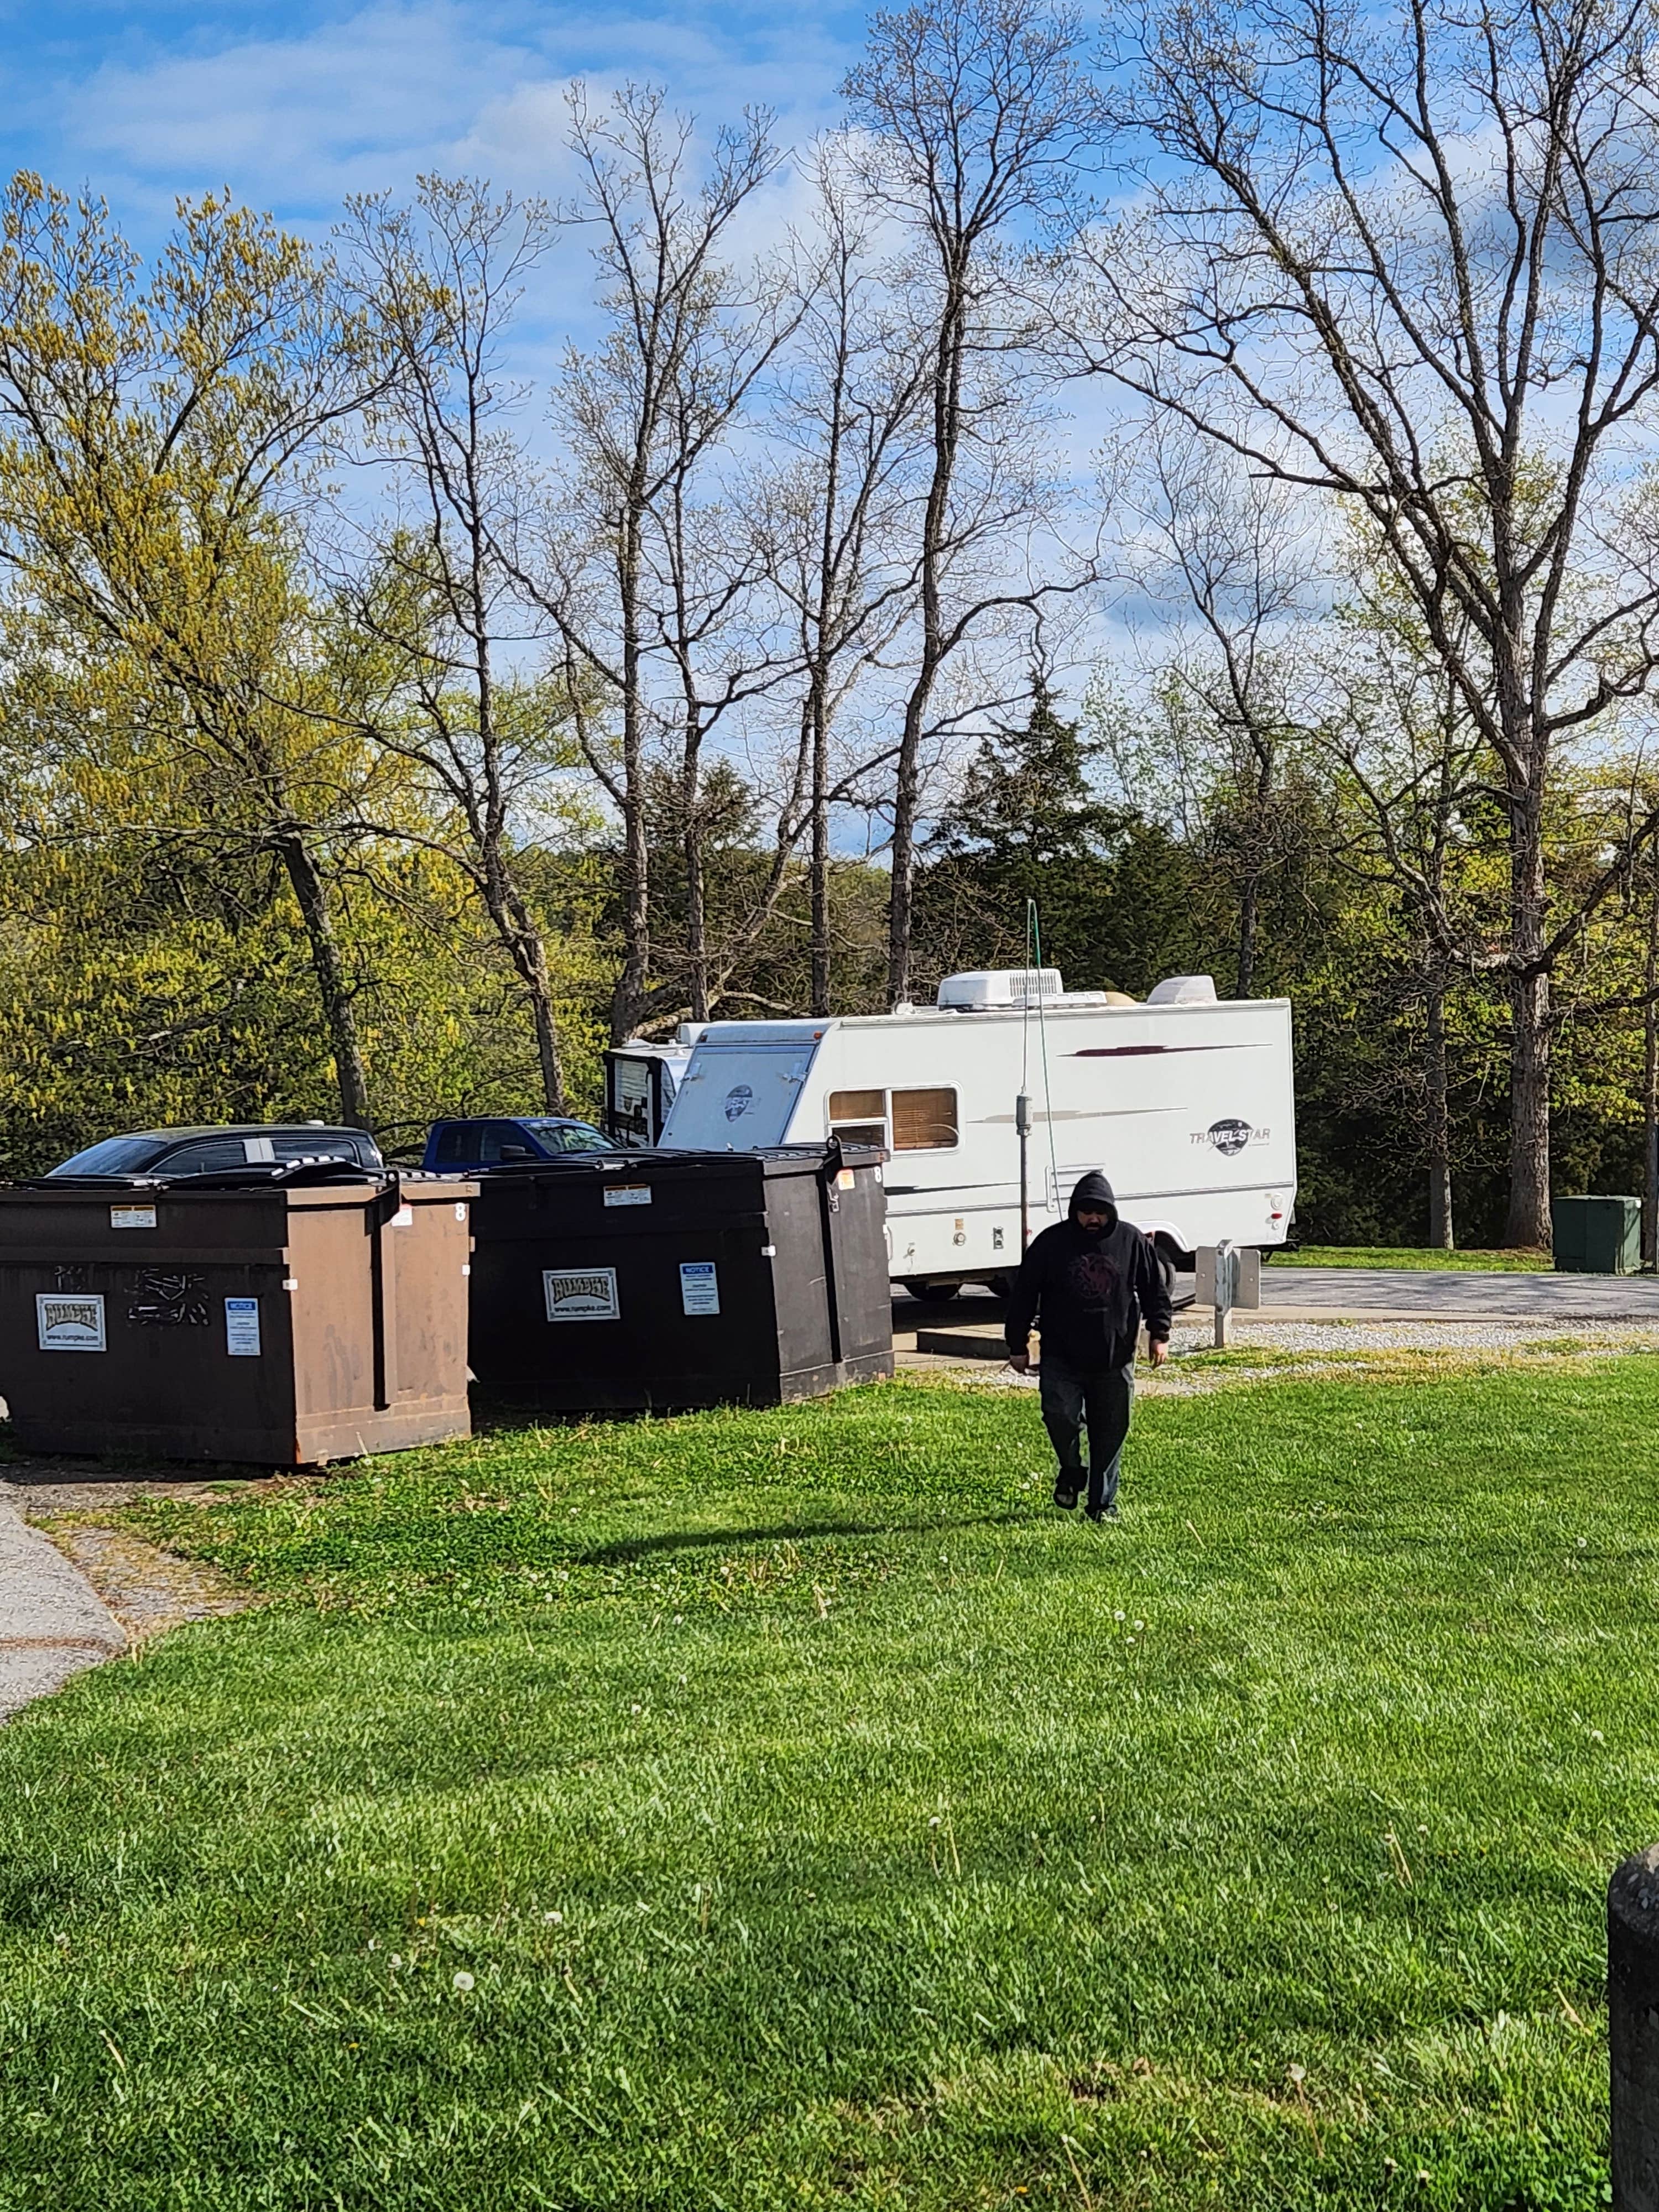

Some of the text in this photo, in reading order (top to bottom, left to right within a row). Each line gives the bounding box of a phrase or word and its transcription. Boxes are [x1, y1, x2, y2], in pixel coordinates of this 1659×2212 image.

[874, 1166, 882, 1183] 8
[455, 1202, 466, 1222] 8
[552, 1275, 611, 1304] RUMPKE
